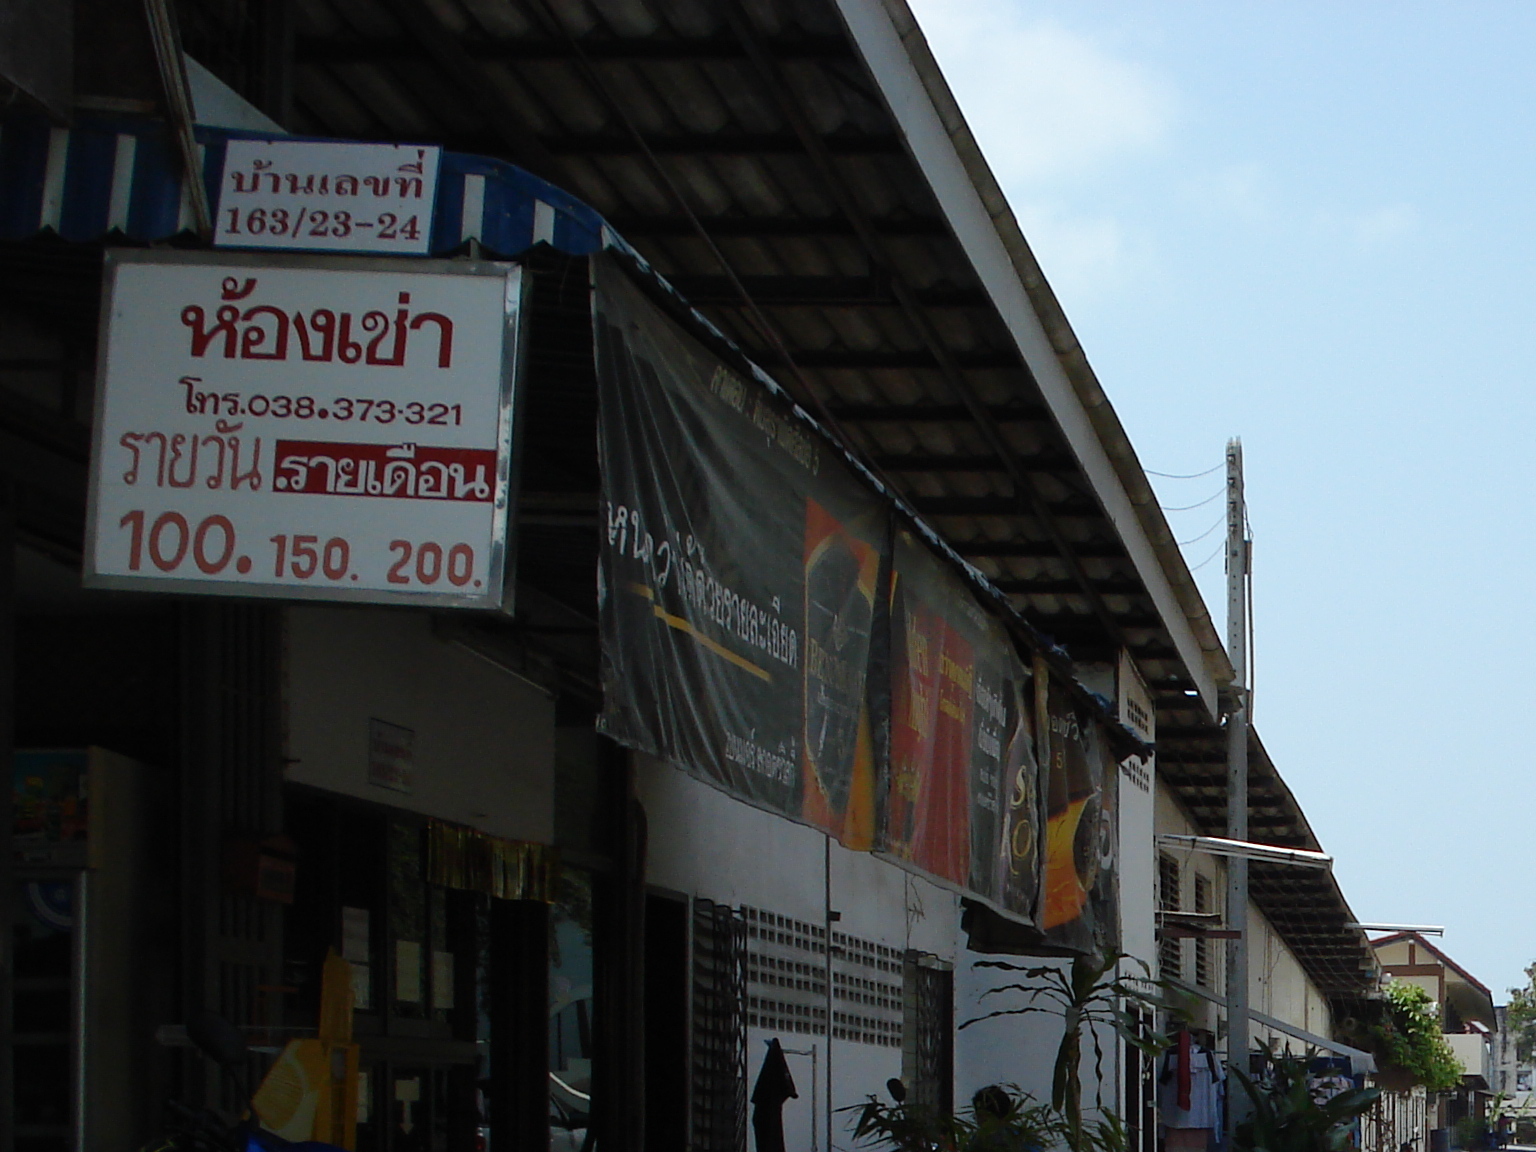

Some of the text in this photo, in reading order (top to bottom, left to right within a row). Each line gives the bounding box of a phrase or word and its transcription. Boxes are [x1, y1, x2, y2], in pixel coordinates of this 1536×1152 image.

[230, 149, 425, 199] บ้านเลขที่
[224, 205, 421, 241] 163/23-24
[180, 275, 454, 369] ห้องเช่า
[119, 418, 263, 492] รายวัน
